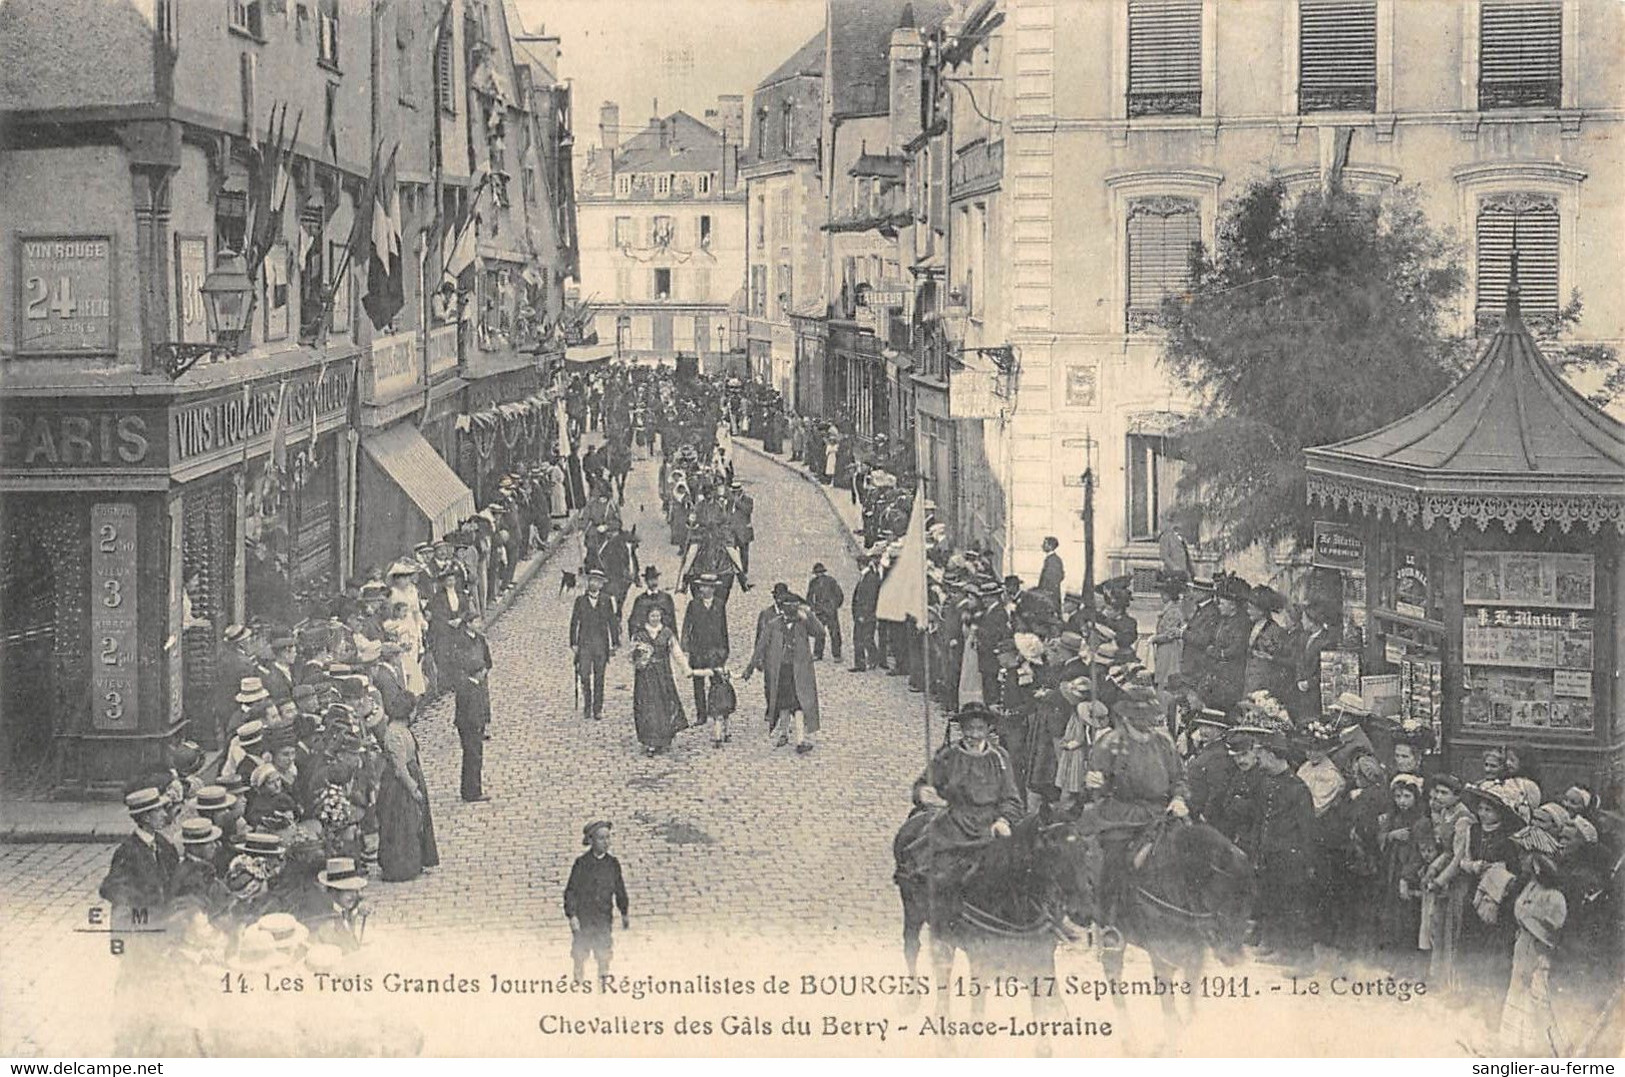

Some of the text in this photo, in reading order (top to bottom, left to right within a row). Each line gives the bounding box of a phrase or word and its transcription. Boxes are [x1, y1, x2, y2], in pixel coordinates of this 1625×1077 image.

[25, 243, 104, 258] VIN ROUGE
[26, 276, 77, 319] 24
[0, 414, 149, 464] PARIS
[176, 407, 213, 459] VINS
[103, 580, 122, 608] 3
[1494, 609, 1562, 627] Le Matin
[105, 692, 122, 719] 3
